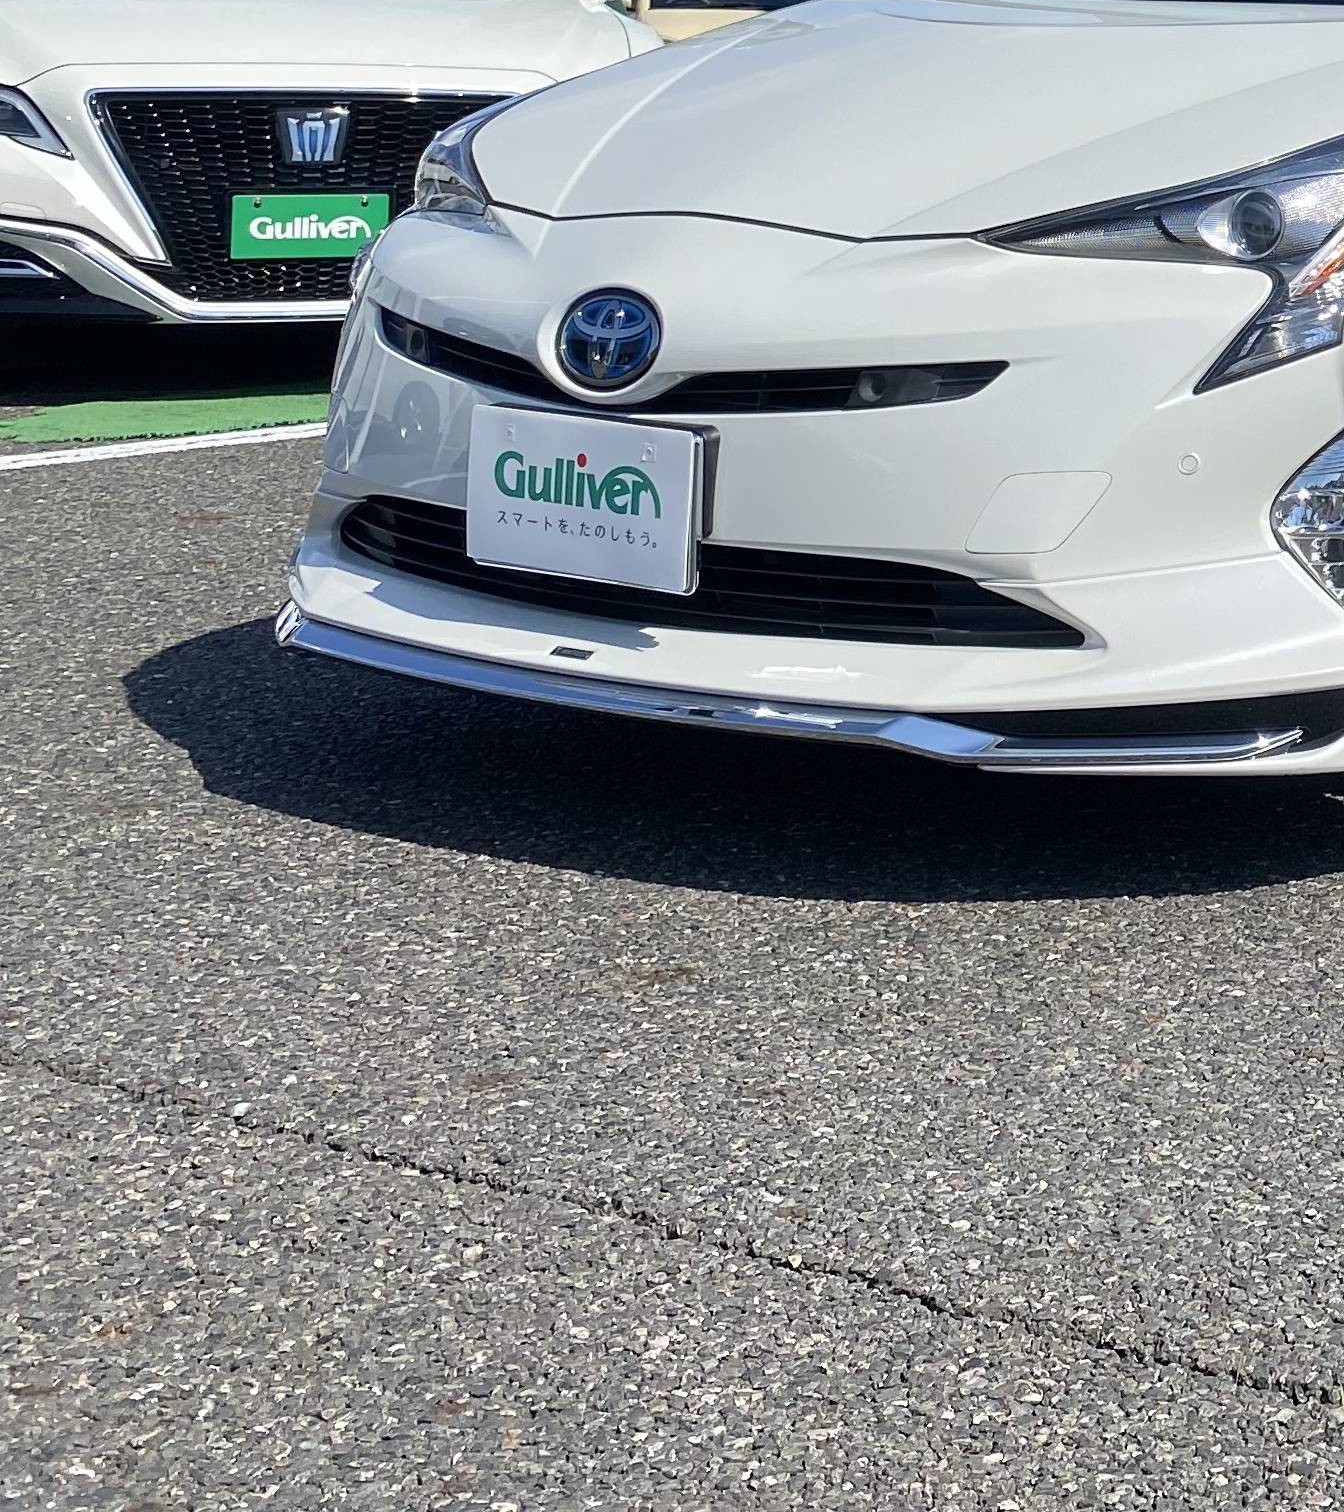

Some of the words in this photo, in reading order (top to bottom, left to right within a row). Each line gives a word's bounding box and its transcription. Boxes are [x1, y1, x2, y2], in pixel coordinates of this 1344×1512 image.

[249, 214, 372, 240] Gulliver
[494, 450, 661, 519] Gulliver
[496, 510, 658, 549] スマートを、たのしもう。
